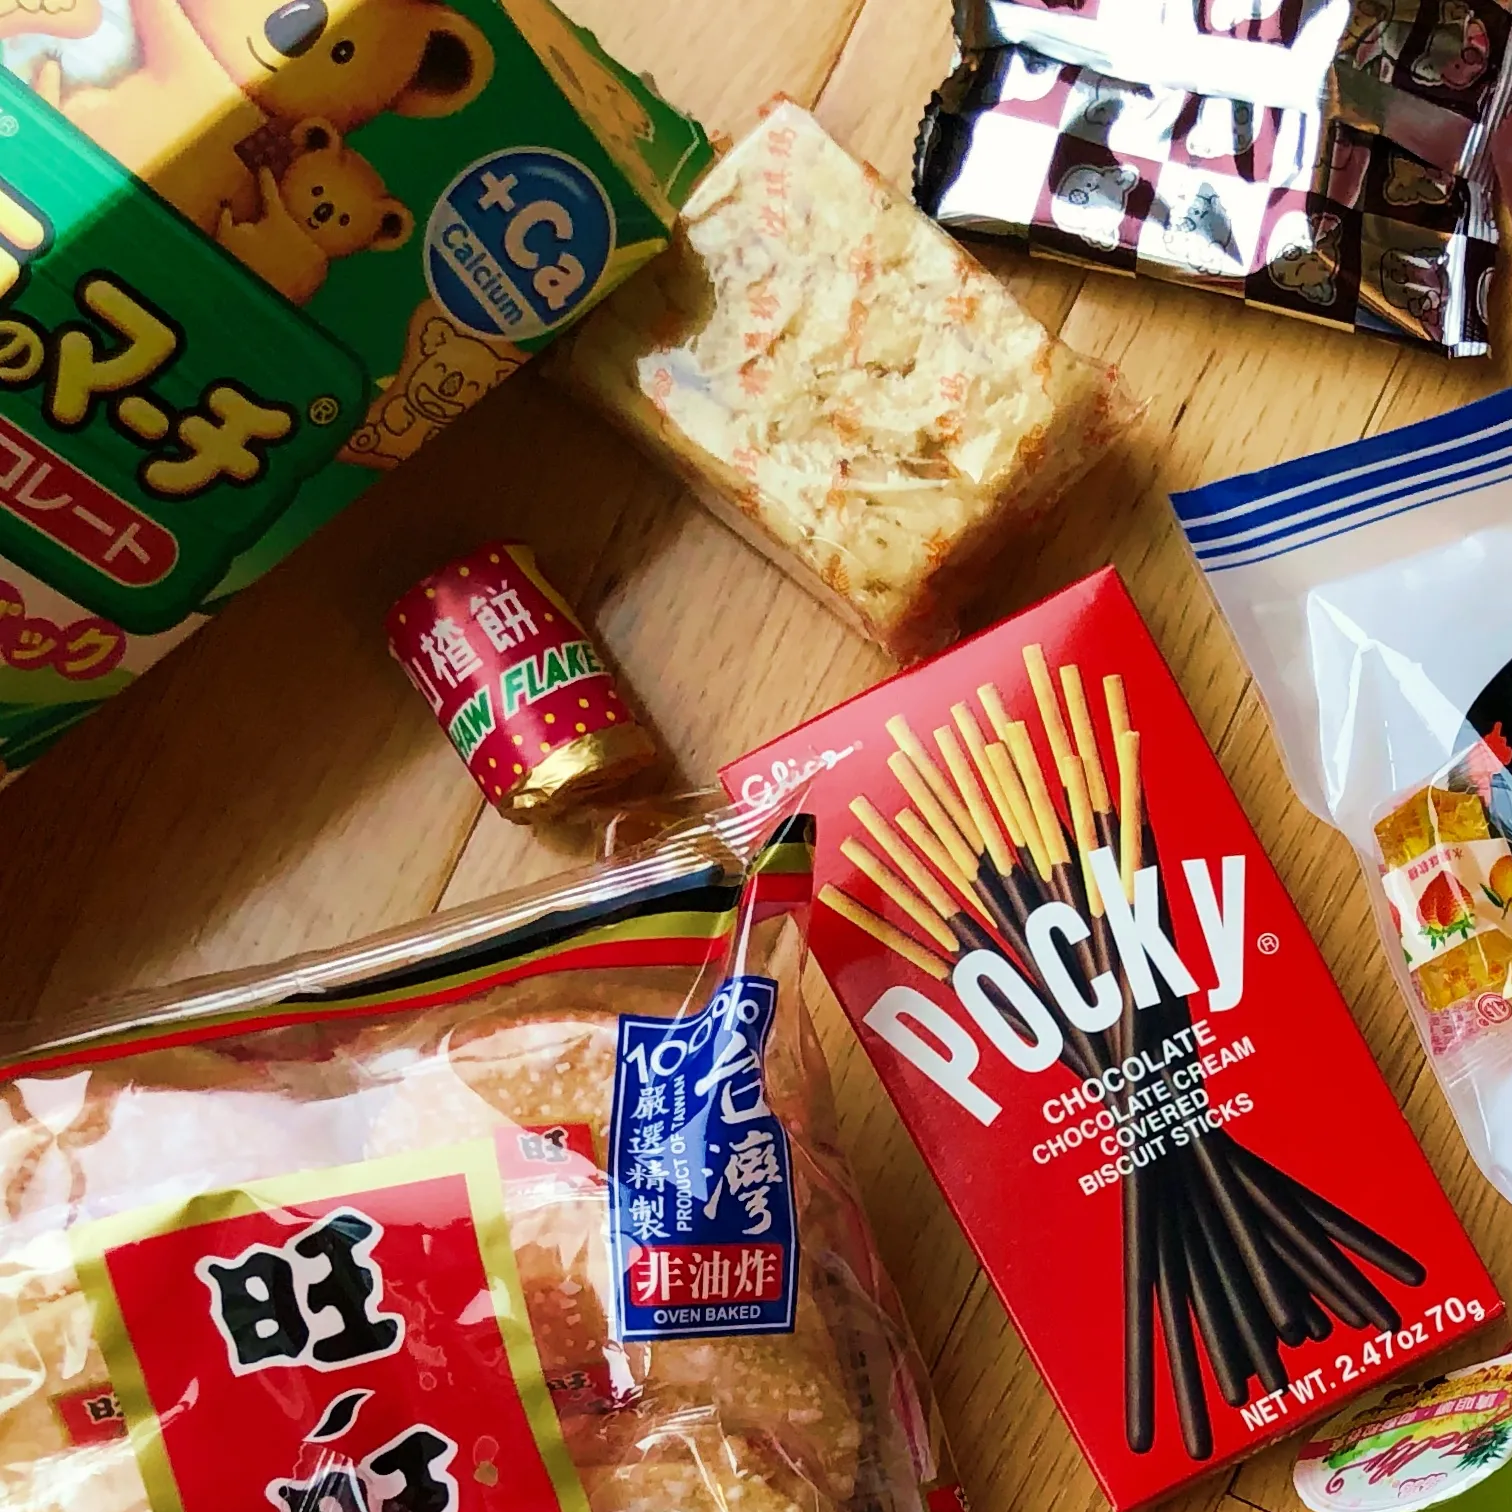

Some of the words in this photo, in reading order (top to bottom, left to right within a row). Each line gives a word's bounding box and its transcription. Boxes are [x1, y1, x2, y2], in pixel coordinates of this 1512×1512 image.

[443, 223, 524, 326] Calcium
[742, 745, 855, 808] Glico
[671, 1075, 686, 1131] TAIWAN
[1032, 1080, 1172, 1164] CHOCOLATE
[1173, 1036, 1256, 1090] CREAM
[1043, 1019, 1216, 1124] CHOCOLATE
[671, 1132, 686, 1155] OF
[1078, 1136, 1167, 1195] BISCUIT
[1171, 1093, 1254, 1146] STICKS
[1100, 1088, 1209, 1156] COVERED
[676, 1163, 694, 1232] PRODUCT
[637, 1250, 778, 1301] 非油炸
[653, 1308, 701, 1324] OVEN
[705, 1305, 761, 1322] BAKED
[1241, 1388, 1292, 1432] NET
[1296, 1369, 1336, 1402] WT.
[1335, 1326, 1428, 1383] 2.47oz
[1425, 1297, 1485, 1333] 70g
